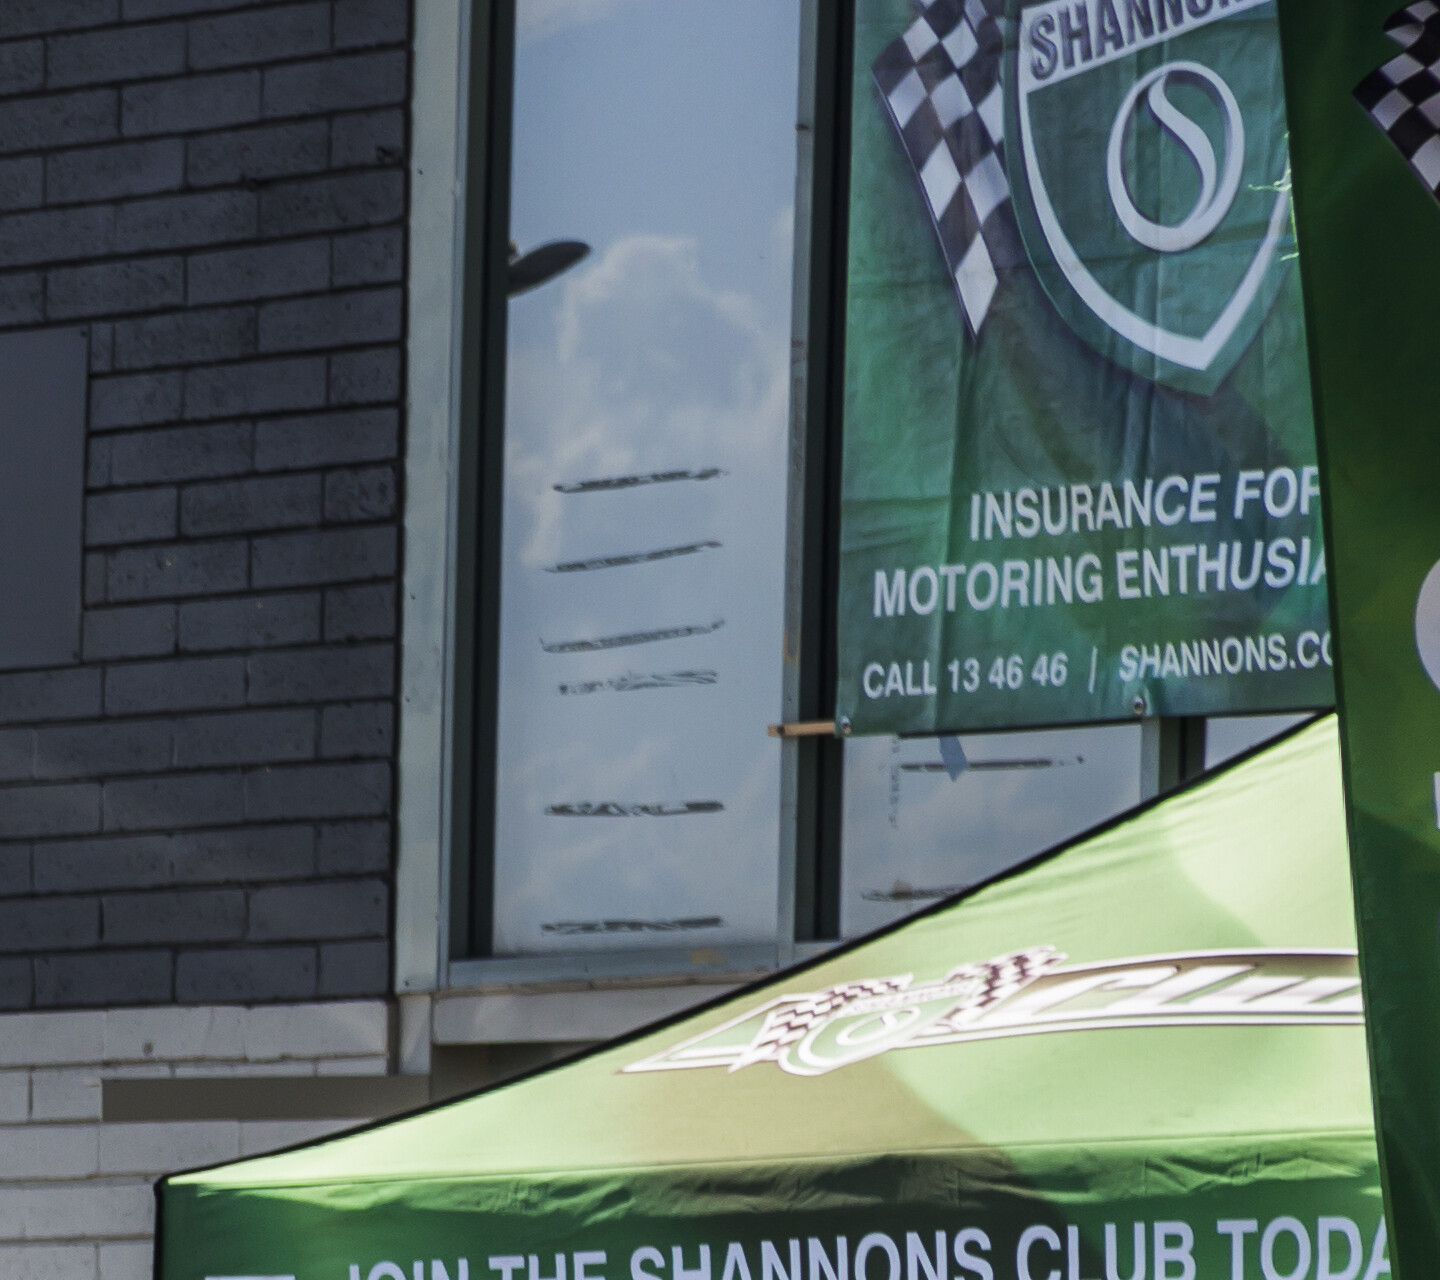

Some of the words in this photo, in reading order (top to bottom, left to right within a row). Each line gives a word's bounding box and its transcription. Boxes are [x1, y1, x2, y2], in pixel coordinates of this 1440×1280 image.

[970, 473, 1221, 542] INSURANCE
[873, 552, 1104, 618] MOTORING
[863, 660, 937, 699] CALL
[947, 658, 980, 693] 13
[988, 655, 1024, 690] 46
[1031, 652, 1068, 687] 46
